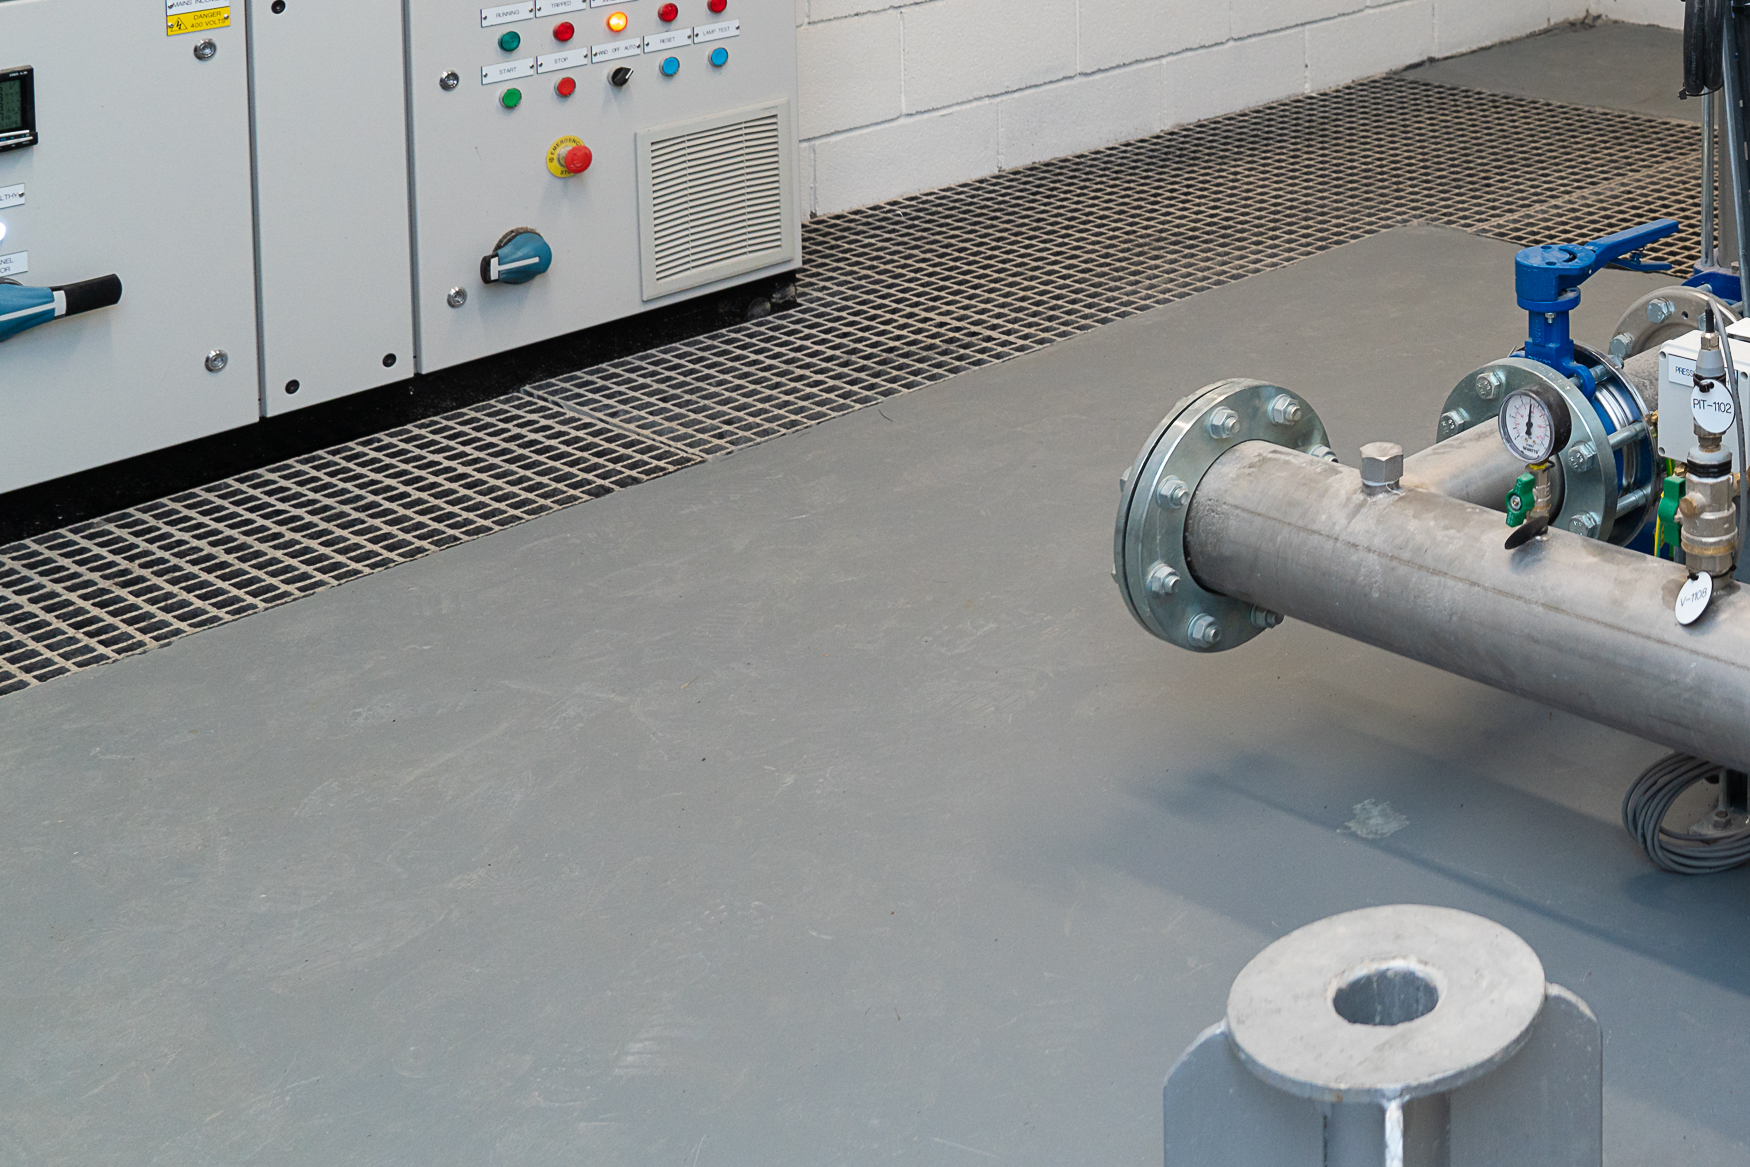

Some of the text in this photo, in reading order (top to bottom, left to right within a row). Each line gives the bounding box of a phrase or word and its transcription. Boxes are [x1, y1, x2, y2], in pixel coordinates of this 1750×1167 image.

[172, 0, 193, 8] MAINS
[551, 0, 572, 9] TRIPPED
[193, 11, 222, 20] DANGER
[495, 9, 520, 18] RUNNING
[659, 36, 676, 44] RESET
[499, 67, 517, 75] START
[1675, 365, 1694, 378] PRESS
[1692, 398, 1732, 414] PIT-1102
[1680, 587, 1708, 607] V-1108
